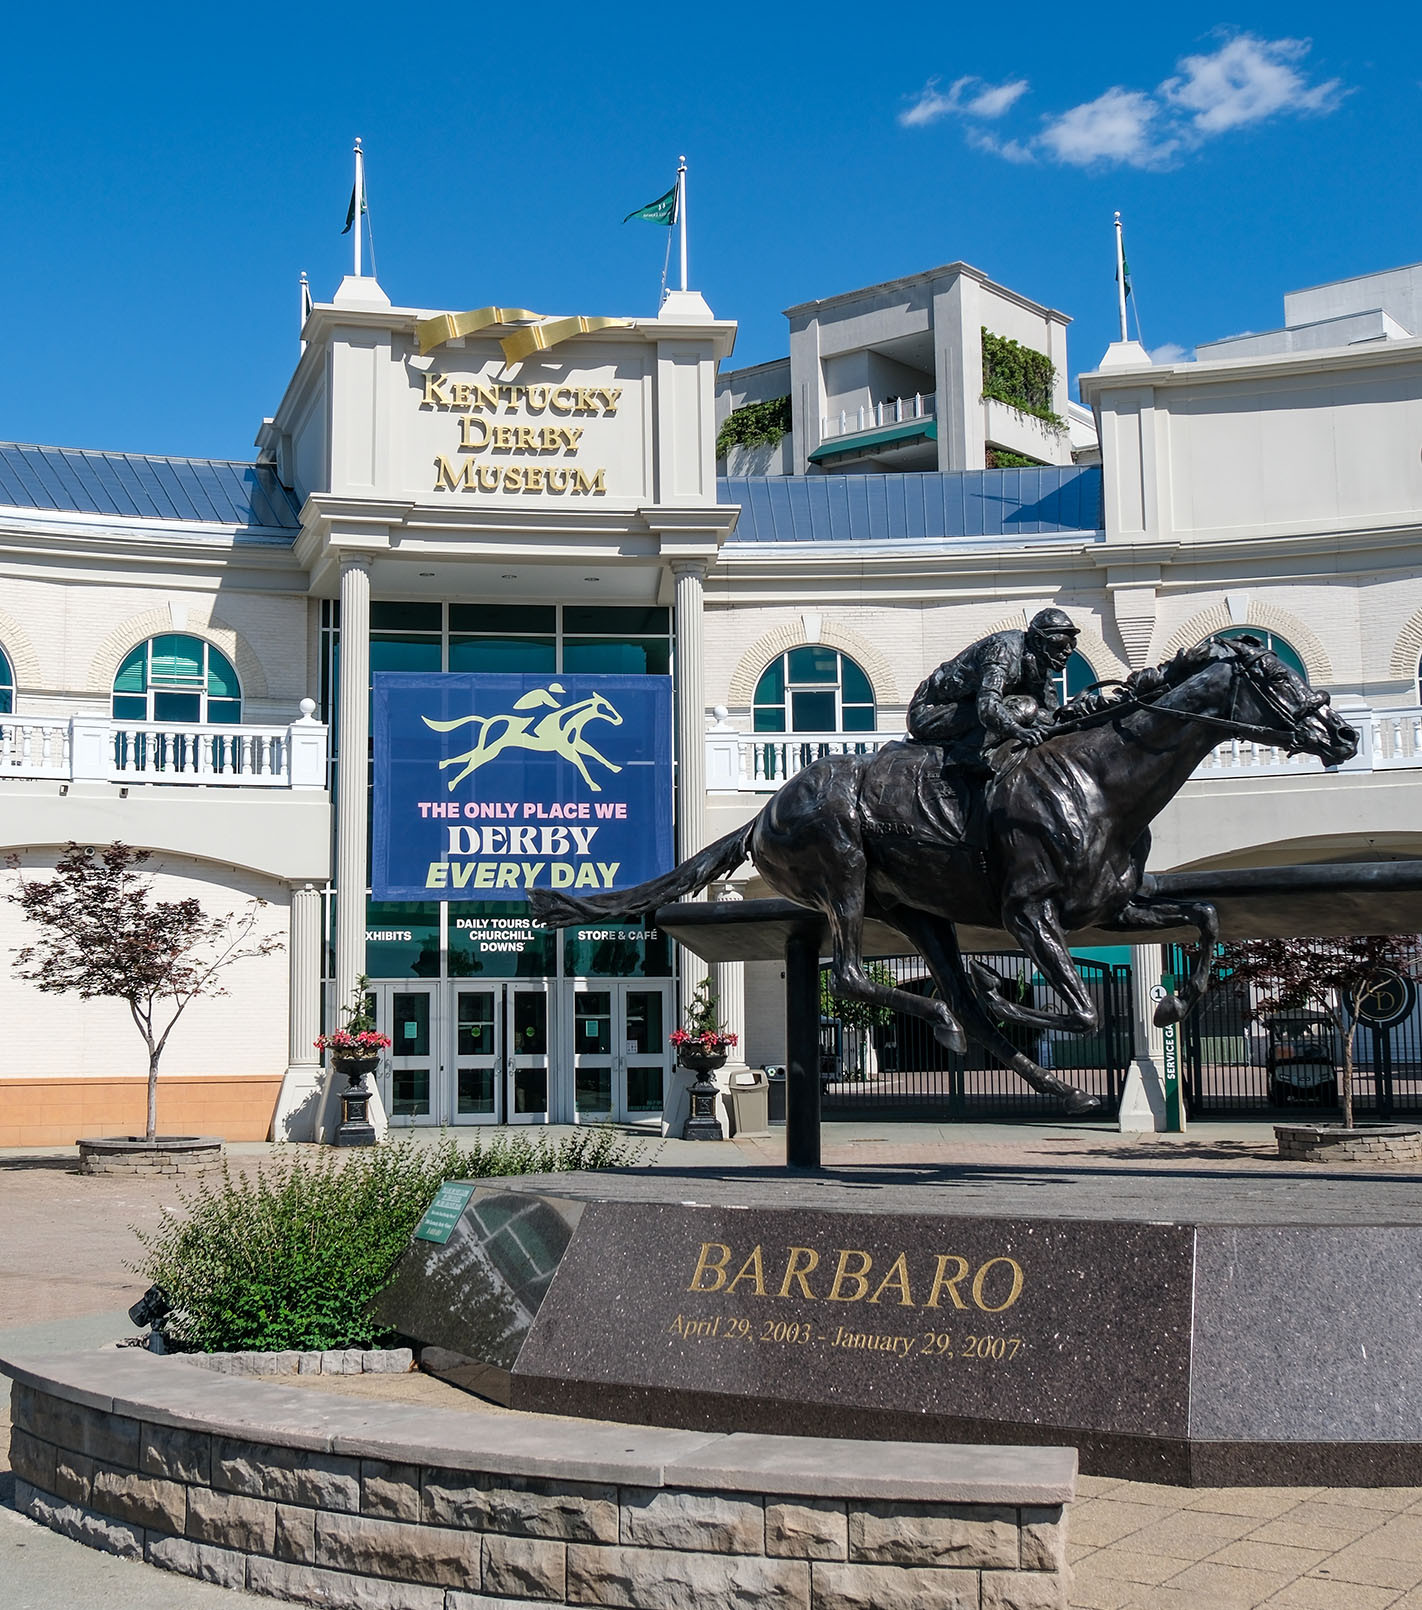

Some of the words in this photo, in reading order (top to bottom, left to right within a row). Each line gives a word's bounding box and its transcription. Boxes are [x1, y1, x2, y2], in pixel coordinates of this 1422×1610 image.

[418, 372, 623, 412] KENTUCKY
[457, 416, 584, 452] DERBY
[434, 455, 607, 495] MUSEUM
[417, 802, 460, 818] THE
[464, 802, 519, 819] ONLY
[523, 803, 591, 819] PLACE
[596, 803, 628, 819] WE
[447, 825, 600, 855] DERBY
[425, 862, 545, 888] EVERY
[550, 862, 621, 889] DAY
[456, 918, 489, 929] DAILY
[490, 918, 530, 929] TOURS
[577, 930, 616, 941] STORE
[617, 931, 626, 941] &
[628, 928, 658, 940] CAFÉ
[365, 931, 412, 941] XHIBITS
[469, 930, 535, 940] CHURCHILL
[480, 941, 525, 952] DOWNS
[1154, 988, 1163, 999] 1
[1165, 1023, 1174, 1038] GA
[1165, 1039, 1176, 1080] SERVICE
[686, 1241, 1025, 1313] BARBARO
[668, 1314, 720, 1341] April
[724, 1317, 753, 1342] 29,
[760, 1322, 811, 1345] 2003
[831, 1326, 915, 1357] January
[920, 1333, 955, 1360] 29,
[962, 1335, 1022, 1362] 2007
